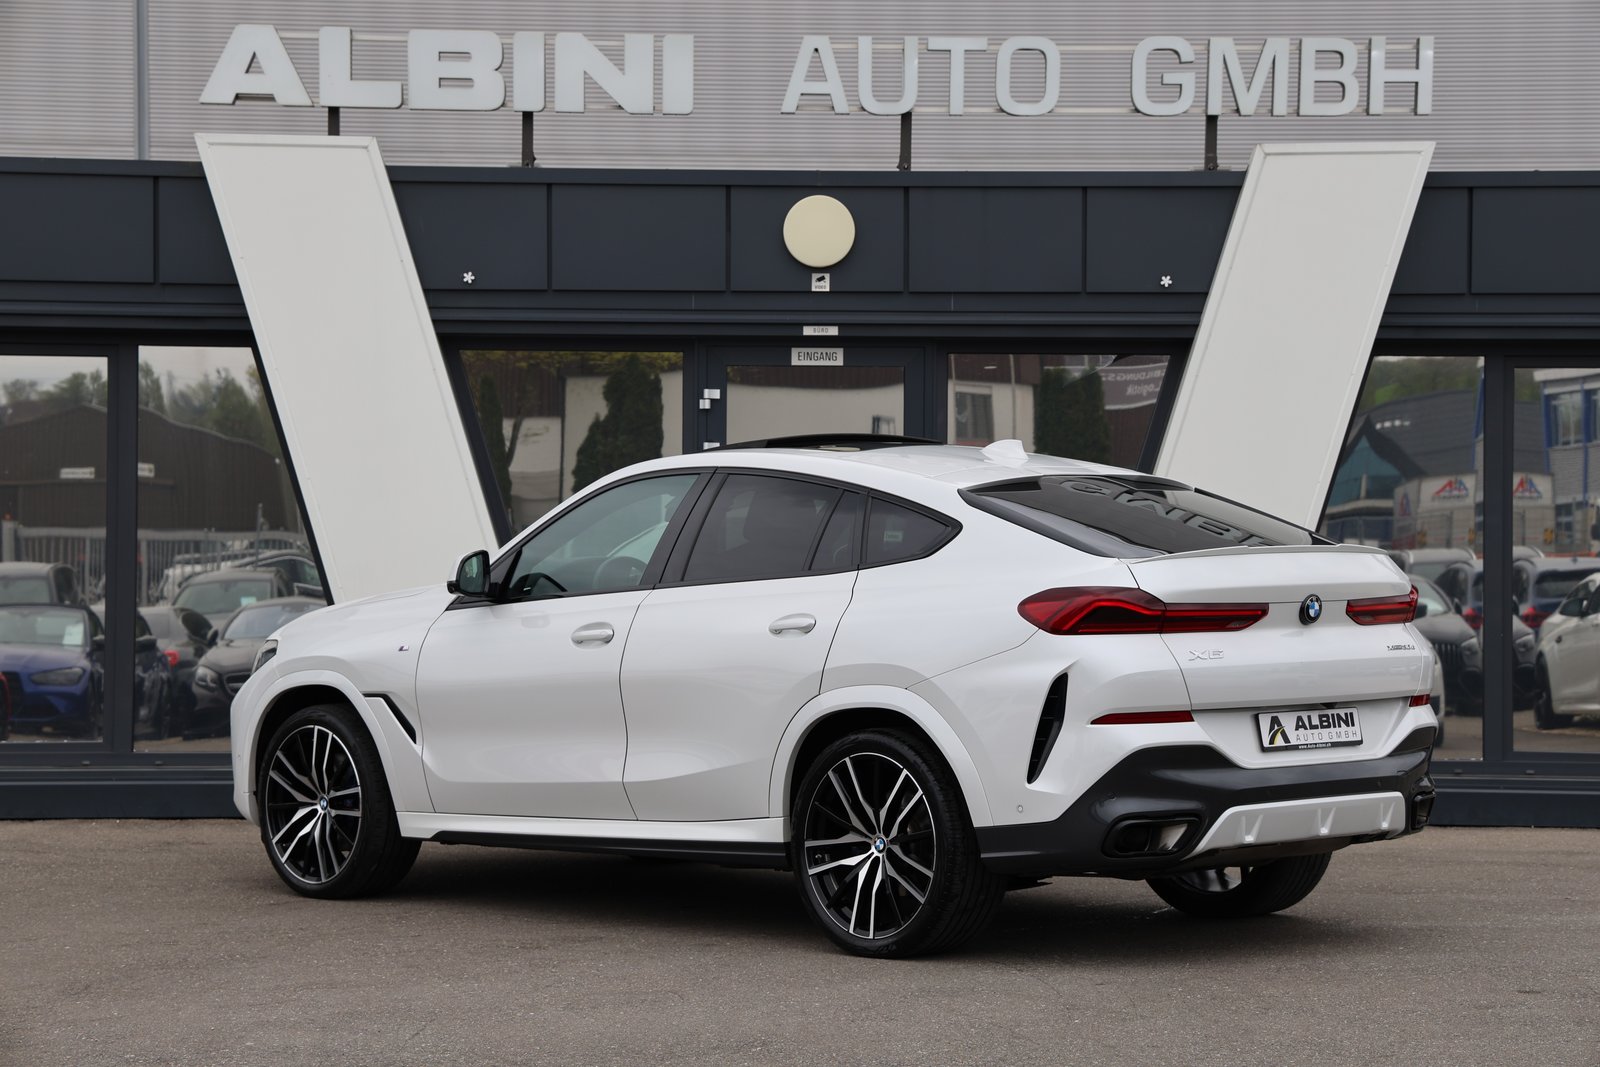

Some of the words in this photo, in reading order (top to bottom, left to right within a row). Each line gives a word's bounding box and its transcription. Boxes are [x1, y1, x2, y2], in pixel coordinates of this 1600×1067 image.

[200, 24, 694, 114] ALBINI
[780, 35, 1062, 116] AUTO
[1131, 35, 1435, 117] GMBH
[812, 326, 829, 334] BÜRO
[797, 351, 838, 362] EINGANG
[1188, 649, 1225, 662] X6
[1294, 711, 1356, 731] ALBINI
[1295, 732, 1324, 742] AUTO
[1327, 730, 1358, 740] GMBH
